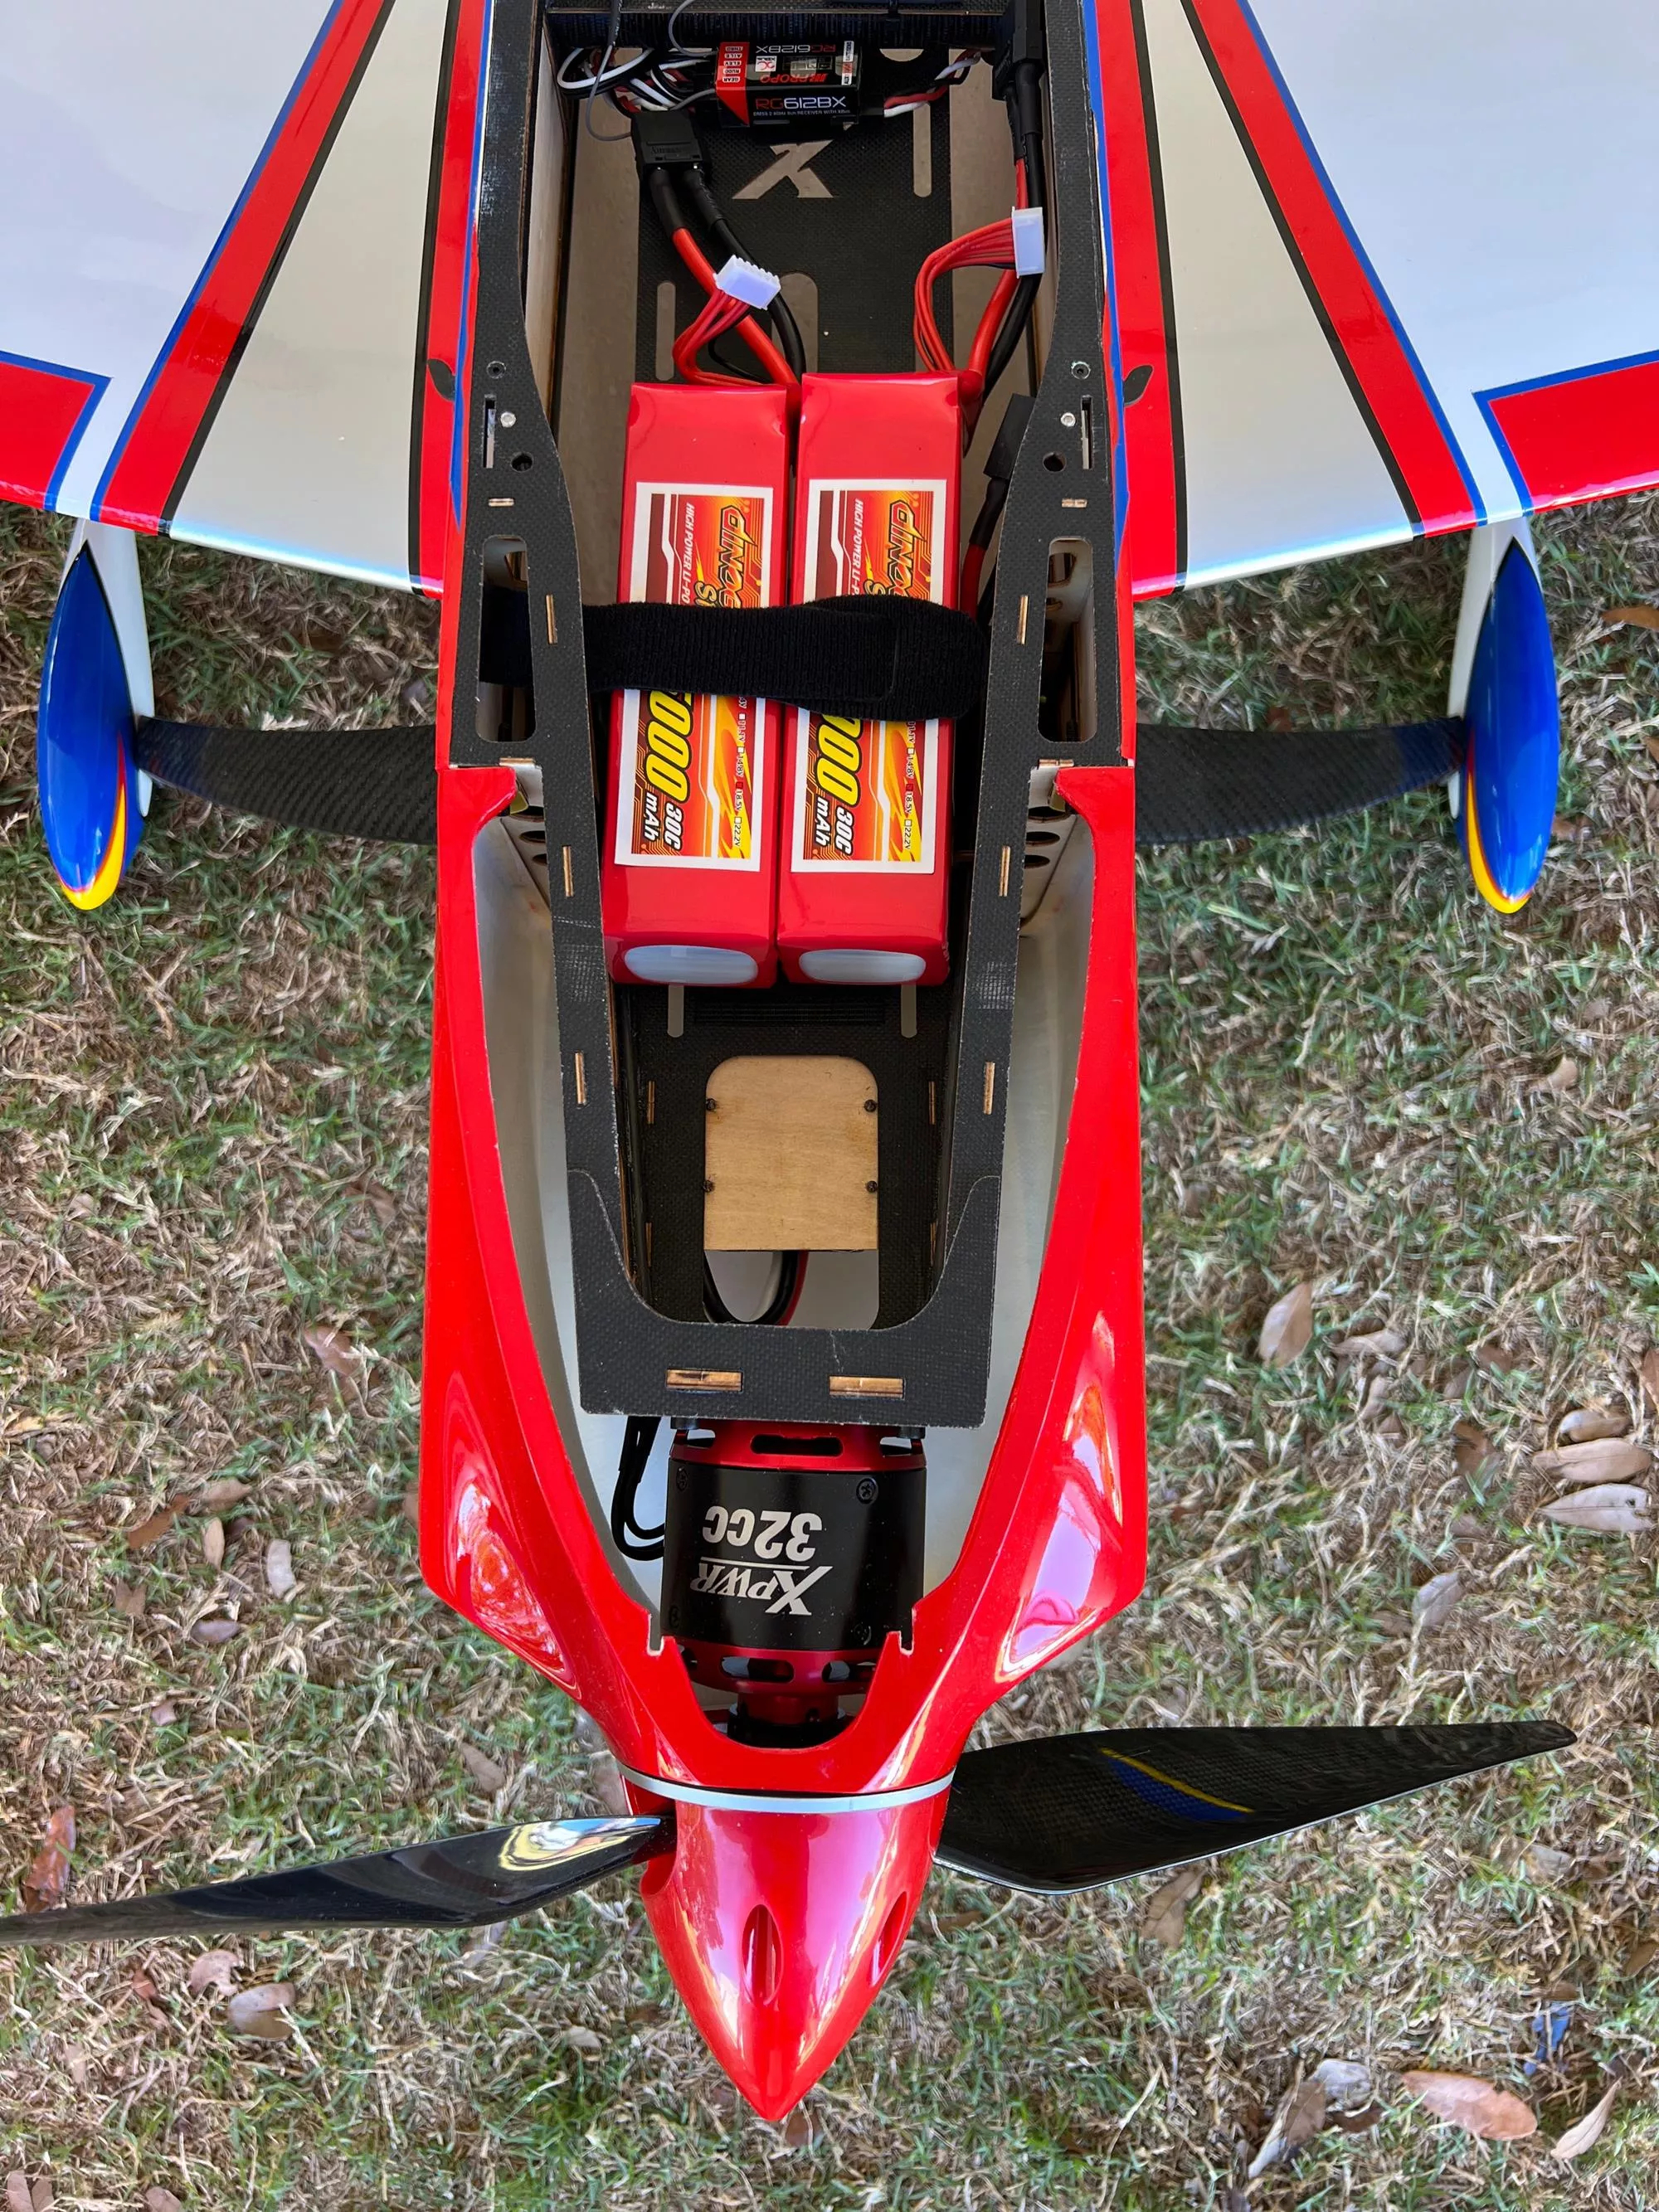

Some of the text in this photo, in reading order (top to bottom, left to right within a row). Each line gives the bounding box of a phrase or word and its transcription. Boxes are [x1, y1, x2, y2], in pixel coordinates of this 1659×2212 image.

[756, 96, 846, 109] RG612BX
[682, 503, 695, 604] HIGH POWER LI-PO
[851, 498, 864, 596] HIGH POWER LI-P
[643, 792, 660, 842] mAh
[734, 790, 743, 811] 18.5V
[815, 796, 831, 846] mAh
[904, 791, 912, 814] 18.5V
[664, 803, 683, 850] 30C
[733, 824, 742, 848] 22.2V
[834, 806, 854, 855] 30C
